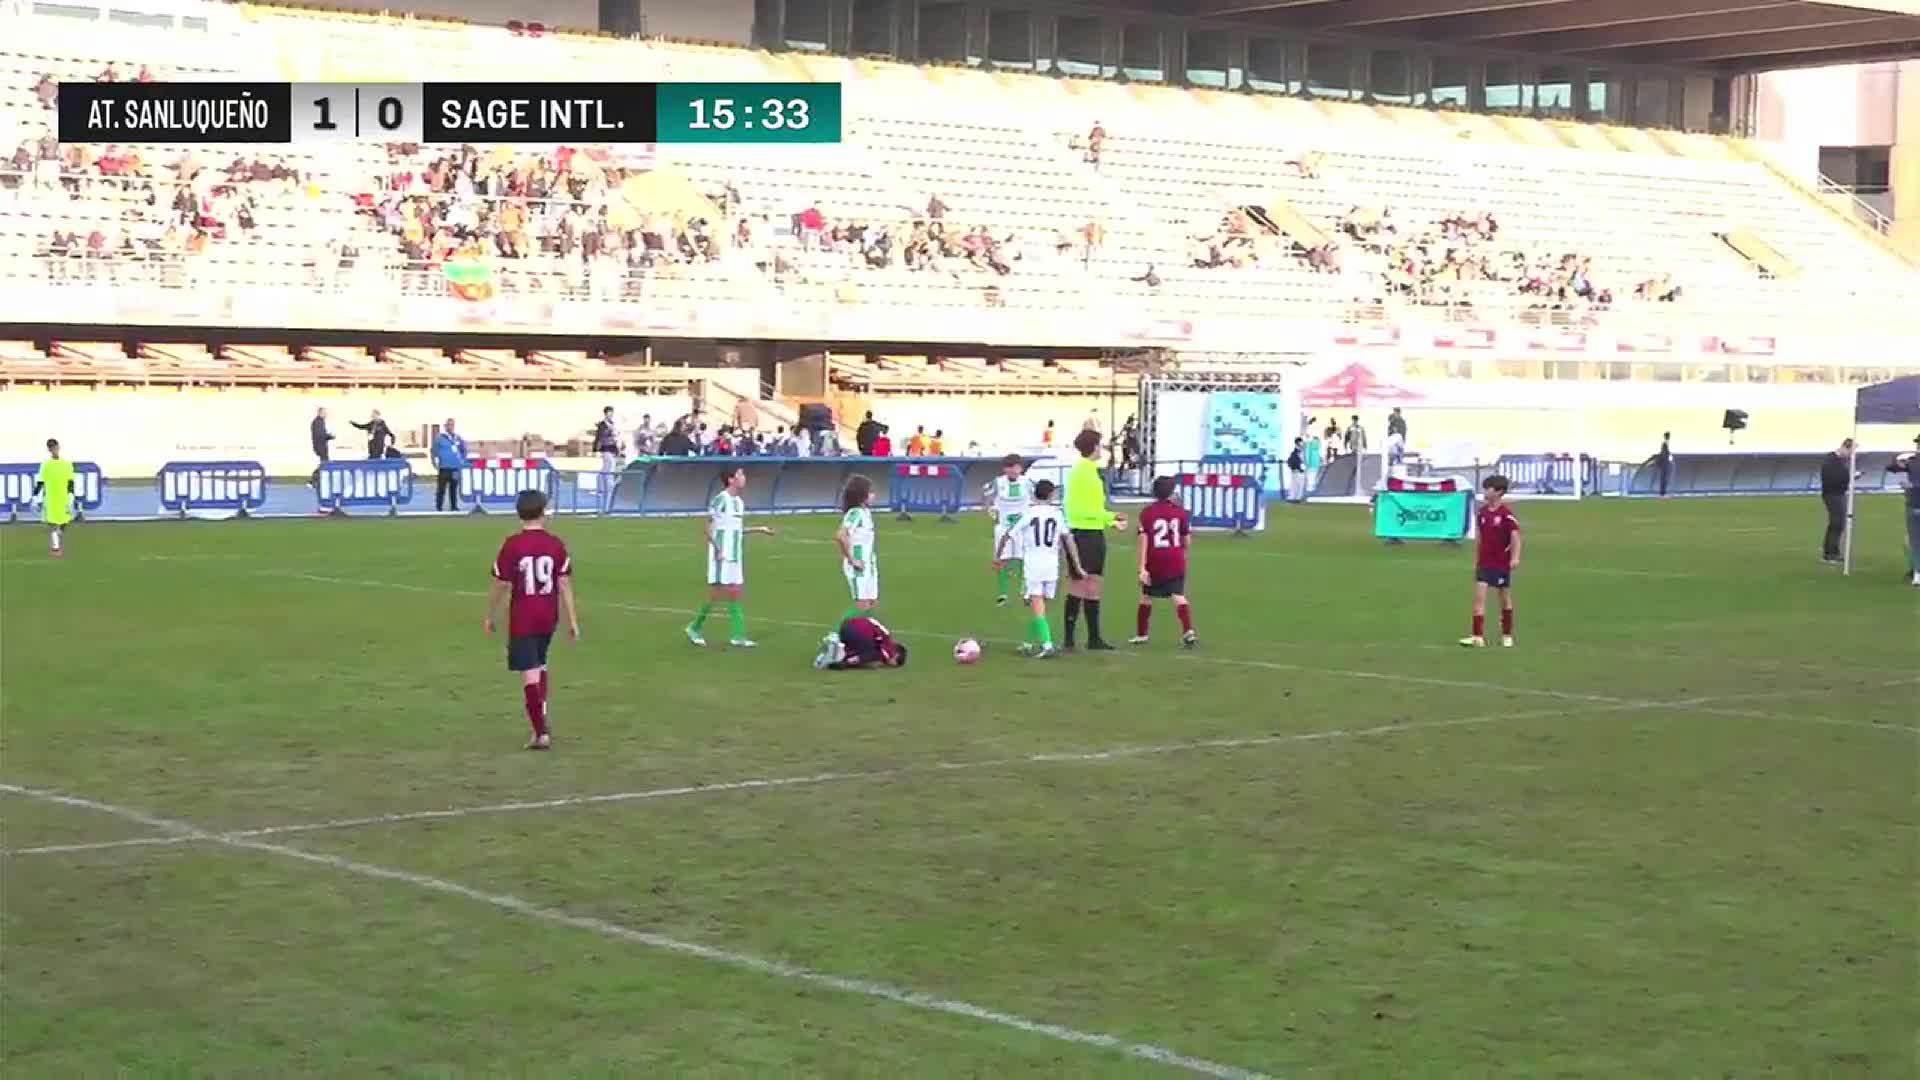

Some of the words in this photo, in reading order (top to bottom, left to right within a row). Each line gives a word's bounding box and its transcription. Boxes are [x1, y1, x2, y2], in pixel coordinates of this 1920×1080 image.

[1030, 516, 1057, 547] 10
[1153, 519, 1182, 548] 21
[518, 555, 555, 596] 19
